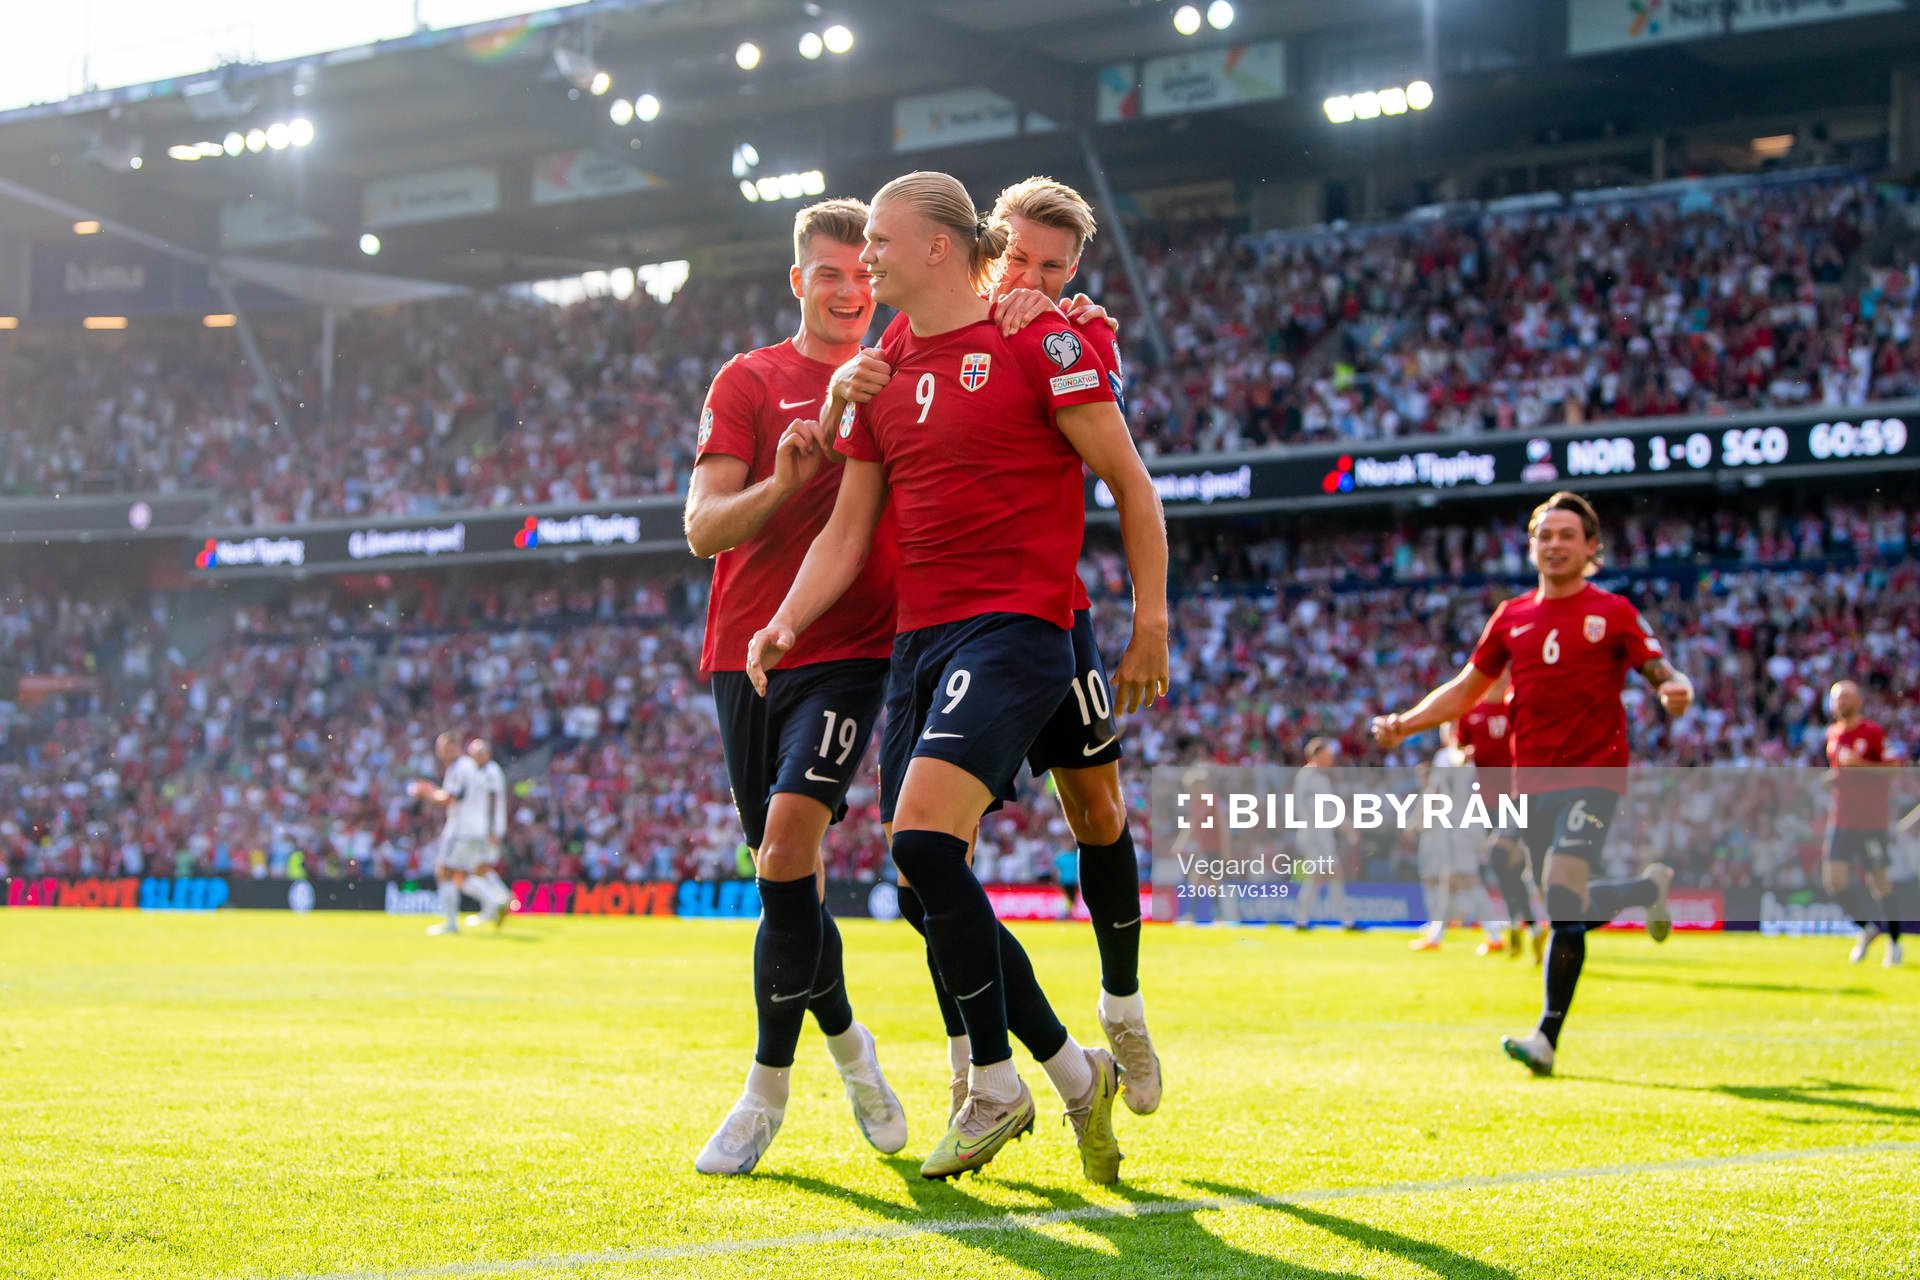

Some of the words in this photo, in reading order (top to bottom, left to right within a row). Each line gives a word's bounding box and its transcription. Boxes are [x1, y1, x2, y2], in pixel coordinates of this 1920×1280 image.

[915, 373, 935, 423] 9
[1052, 373, 1099, 390] FOUNDATION
[1567, 438, 1635, 476] NOR
[1648, 433, 1712, 471] 1-0
[1722, 426, 1789, 466] SCO
[1808, 417, 1908, 460] 60:59
[1542, 628, 1560, 665] 6
[941, 669, 971, 714] 9
[1071, 669, 1110, 725] 10
[819, 710, 858, 766] 19
[1567, 799, 1586, 831] 6
[8, 876, 59, 909] EAT
[59, 877, 140, 911] MOVE
[138, 876, 230, 913] SLEEP
[510, 880, 575, 914] EAT
[574, 882, 678, 917] MOVE
[676, 880, 763, 918] SLEE
